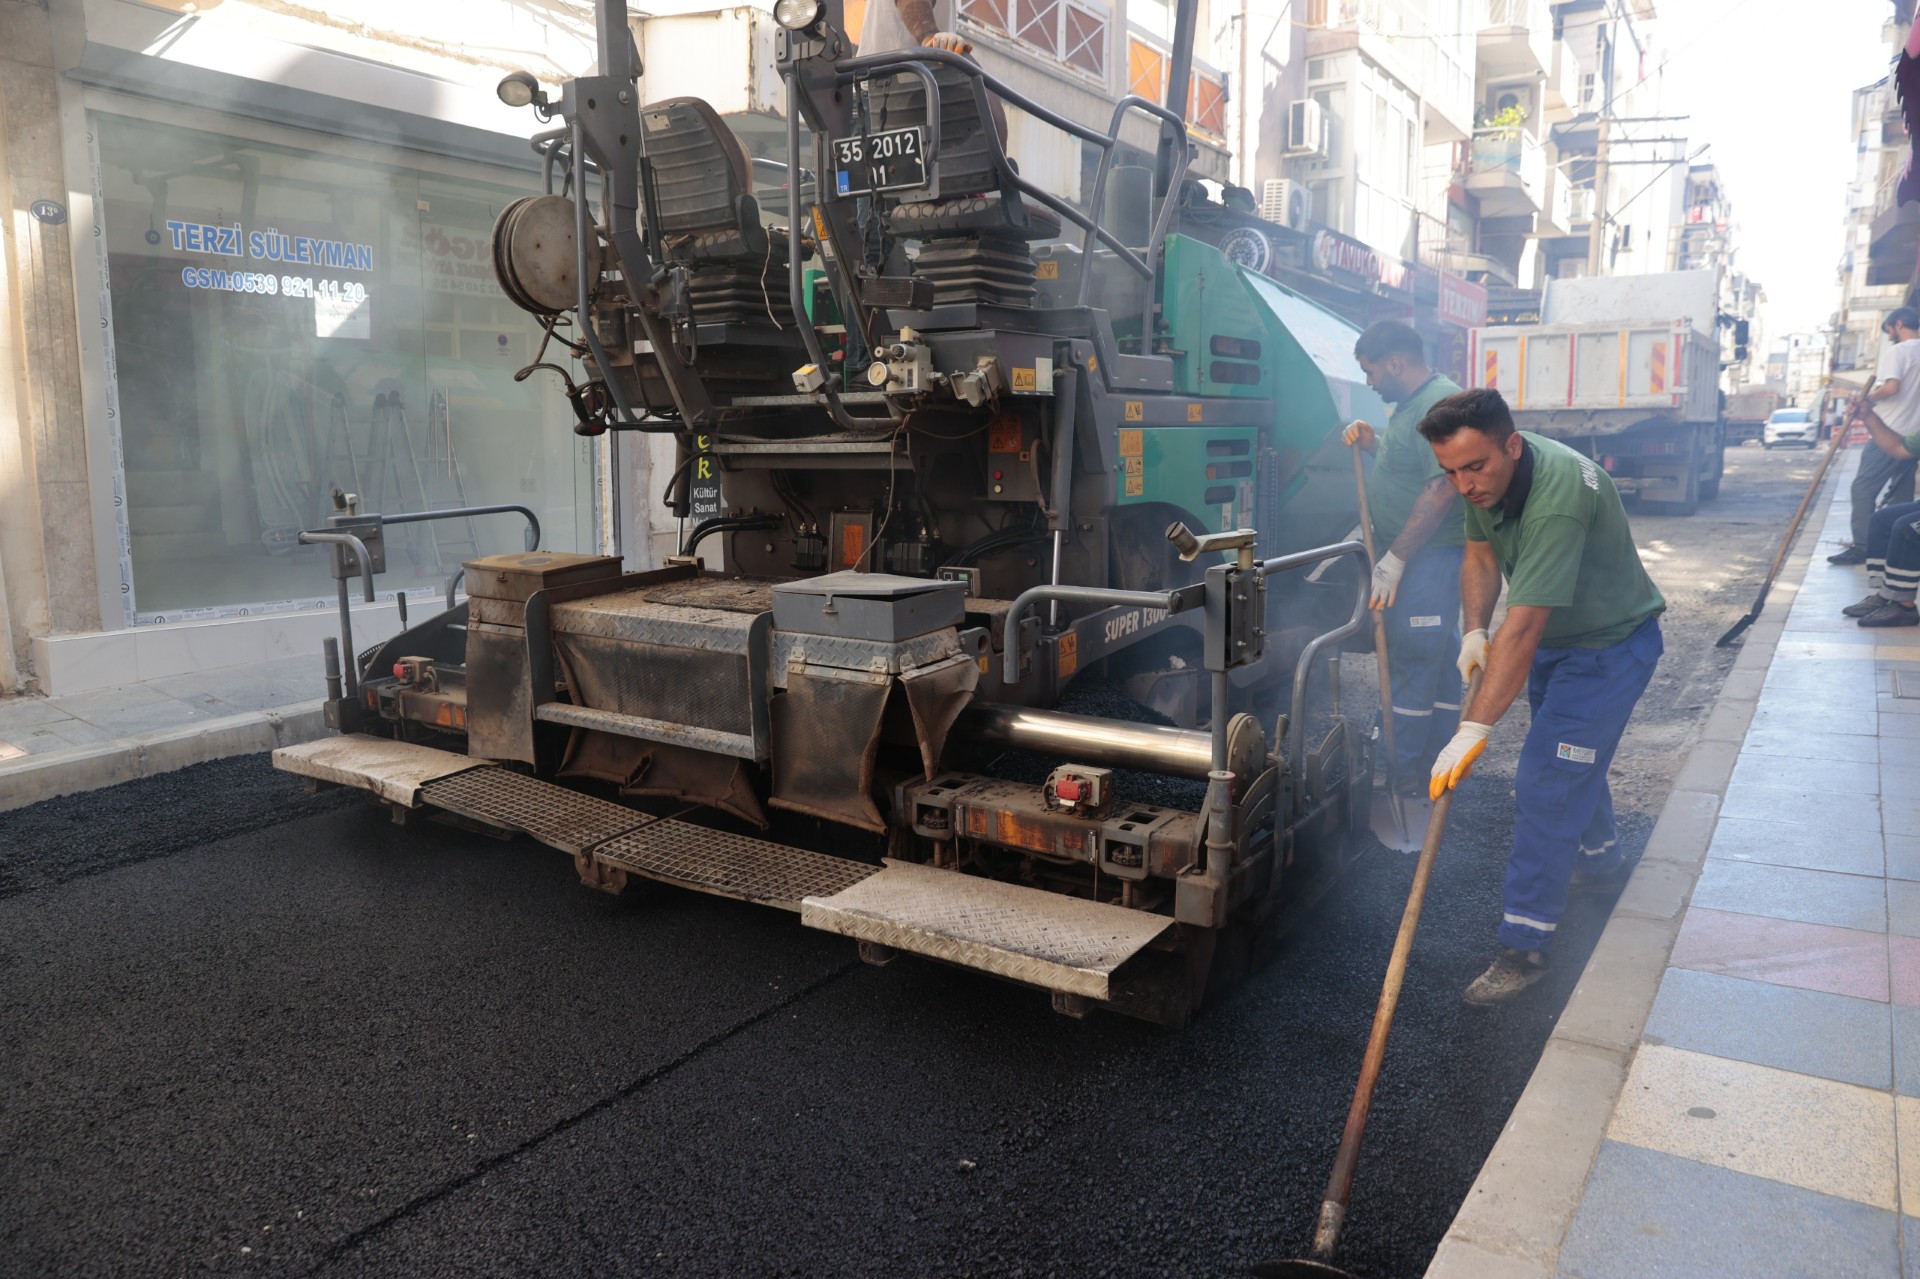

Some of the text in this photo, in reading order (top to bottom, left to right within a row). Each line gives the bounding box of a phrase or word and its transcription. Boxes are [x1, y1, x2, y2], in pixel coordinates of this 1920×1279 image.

[840, 132, 915, 163] 35 2012
[166, 219, 243, 257] TERZİ
[249, 227, 373, 271] SÜLEYMAN
[182, 267, 365, 303] GSM:0539 921 11 20
[693, 487, 718, 499] Kültür
[694, 502, 718, 513] Sanat
[1104, 610, 1140, 643] SUPER
